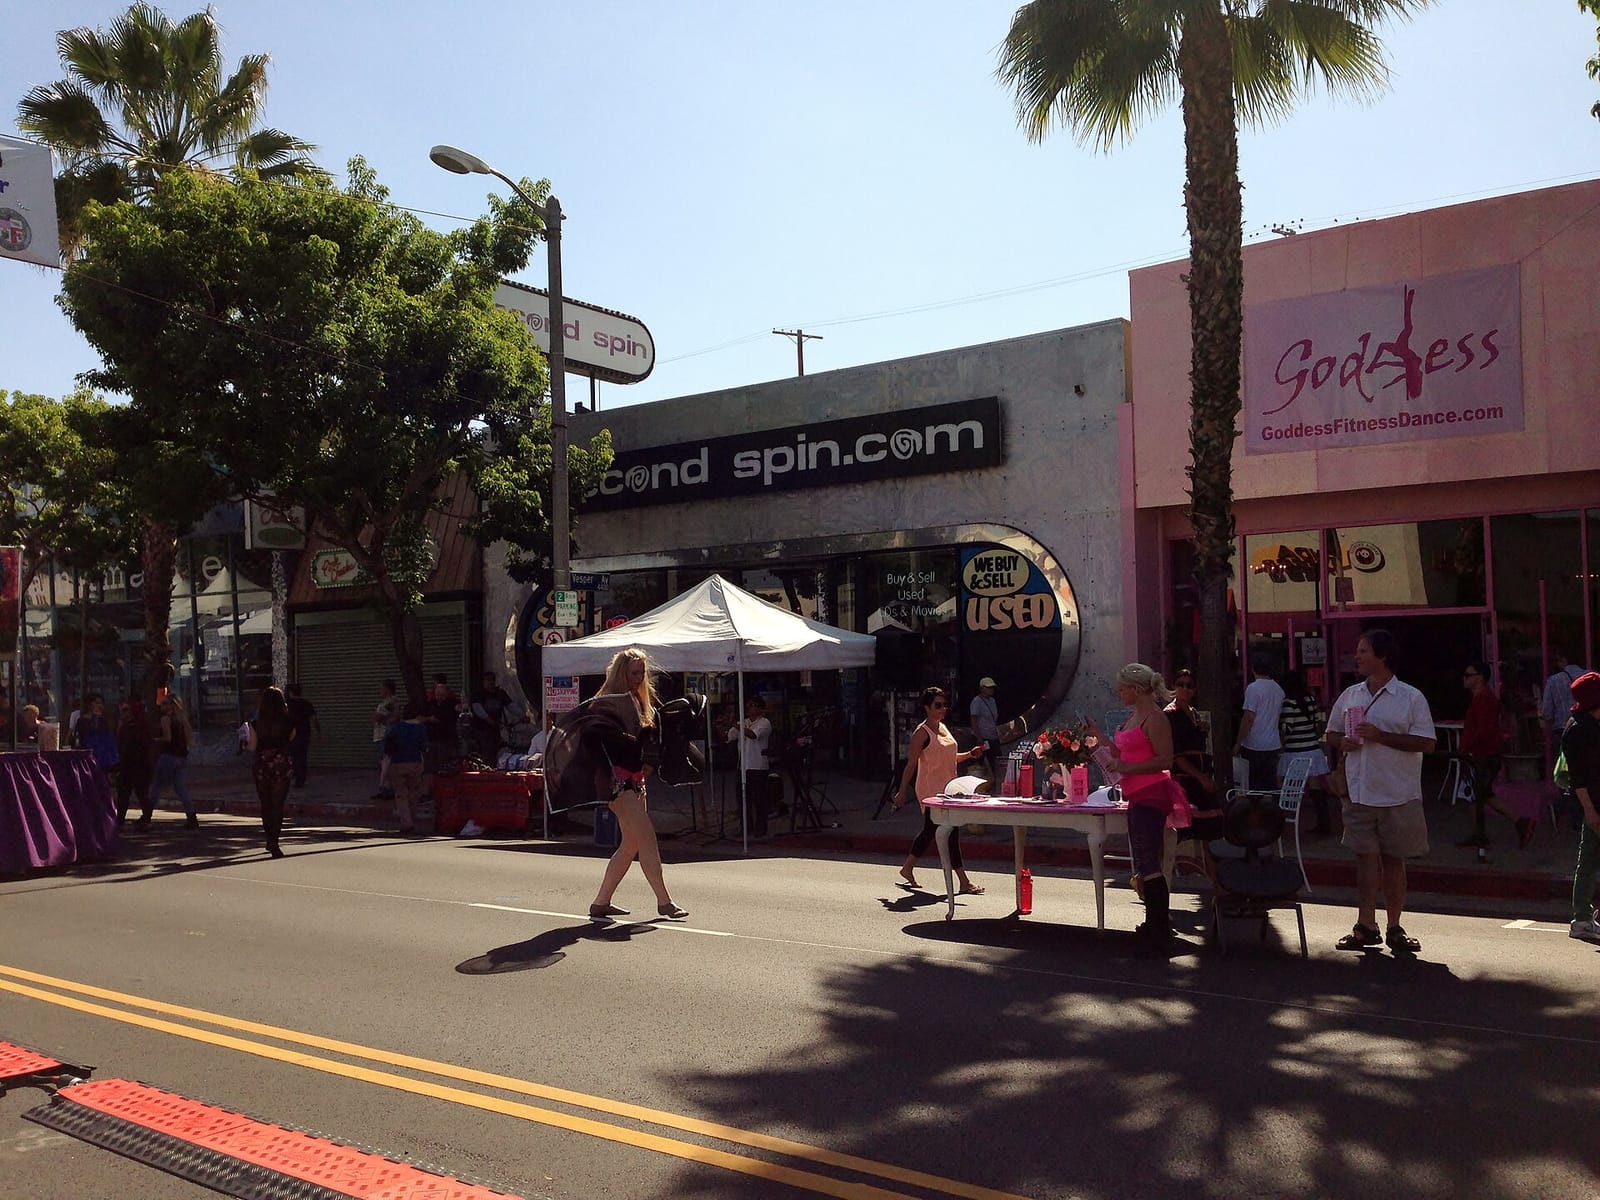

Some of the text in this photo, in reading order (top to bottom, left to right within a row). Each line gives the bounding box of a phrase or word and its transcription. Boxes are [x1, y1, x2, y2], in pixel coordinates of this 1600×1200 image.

[593, 334, 647, 360] spin
[1262, 405, 1503, 441] GoddessFitnessDance.com
[584, 420, 984, 498] cond spin.com
[973, 555, 1019, 572] WE BUY
[887, 571, 936, 587] Buy & Sell
[897, 587, 925, 601] Used
[900, 605, 907, 617] &
